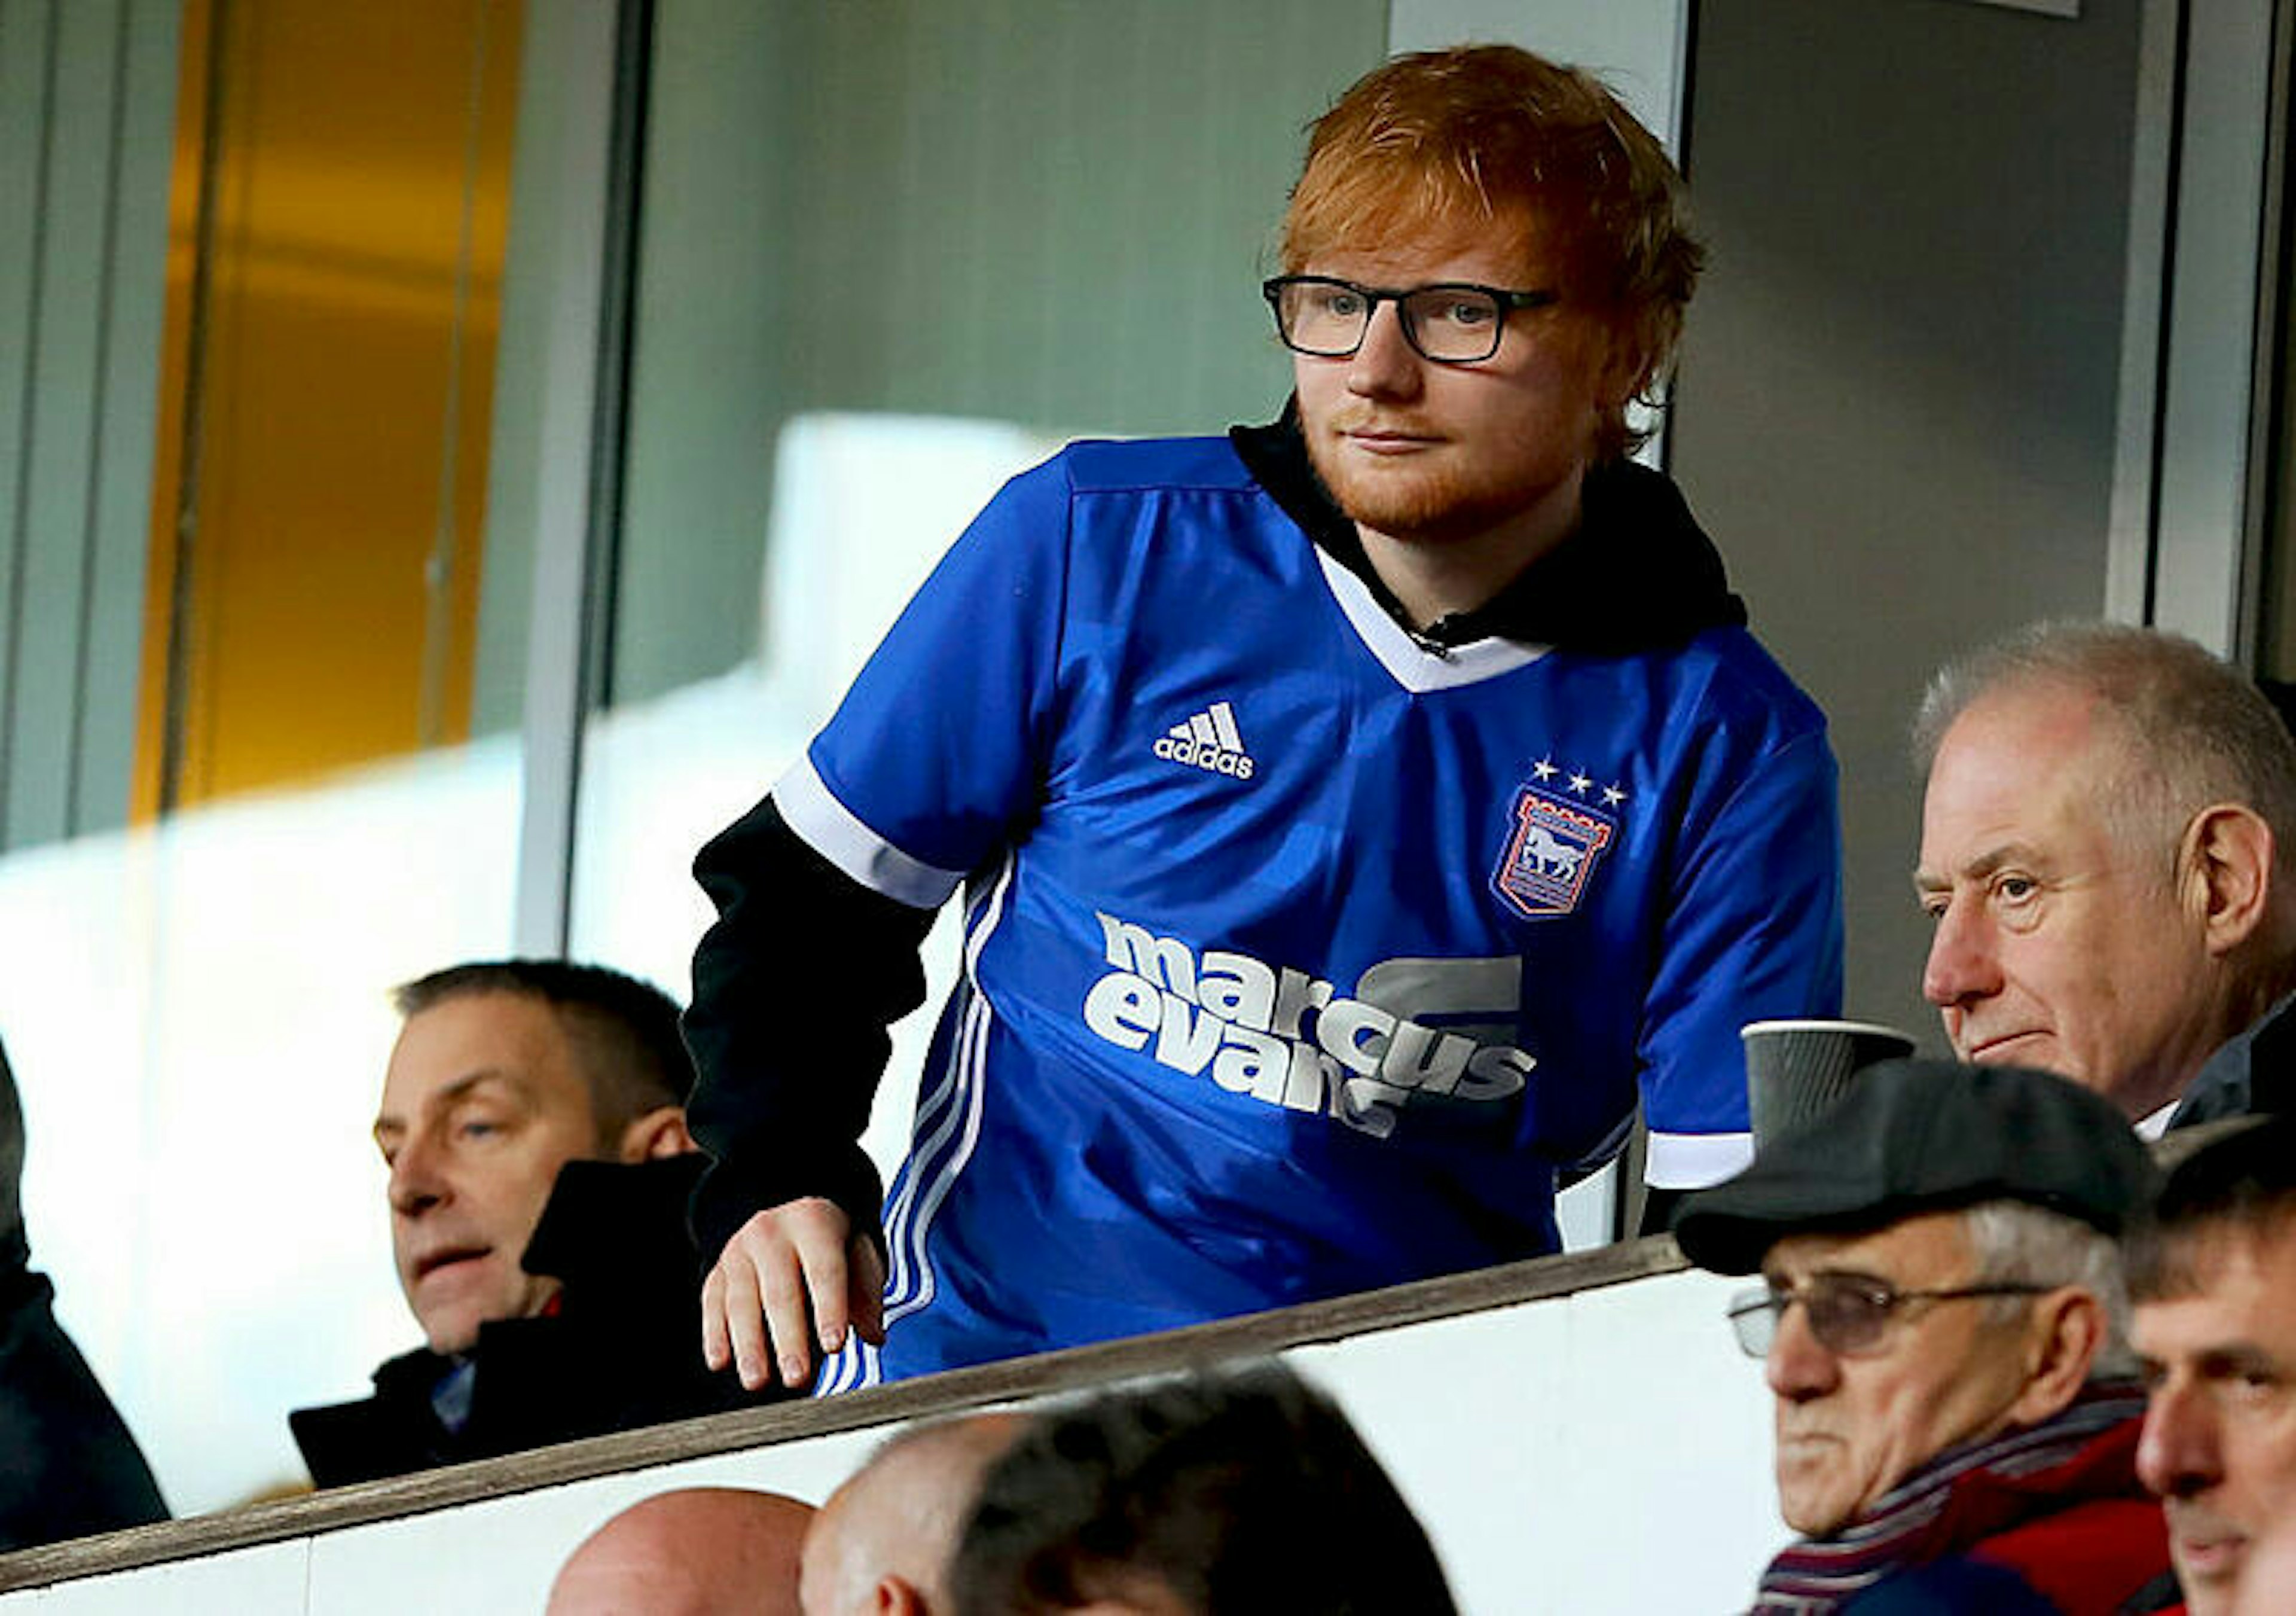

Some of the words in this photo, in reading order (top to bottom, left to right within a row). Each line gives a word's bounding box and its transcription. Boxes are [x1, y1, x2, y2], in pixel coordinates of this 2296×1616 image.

[1153, 737, 1254, 779] adidas
[1083, 971, 1412, 1140] evans
[1095, 910, 1537, 1100] marcus
